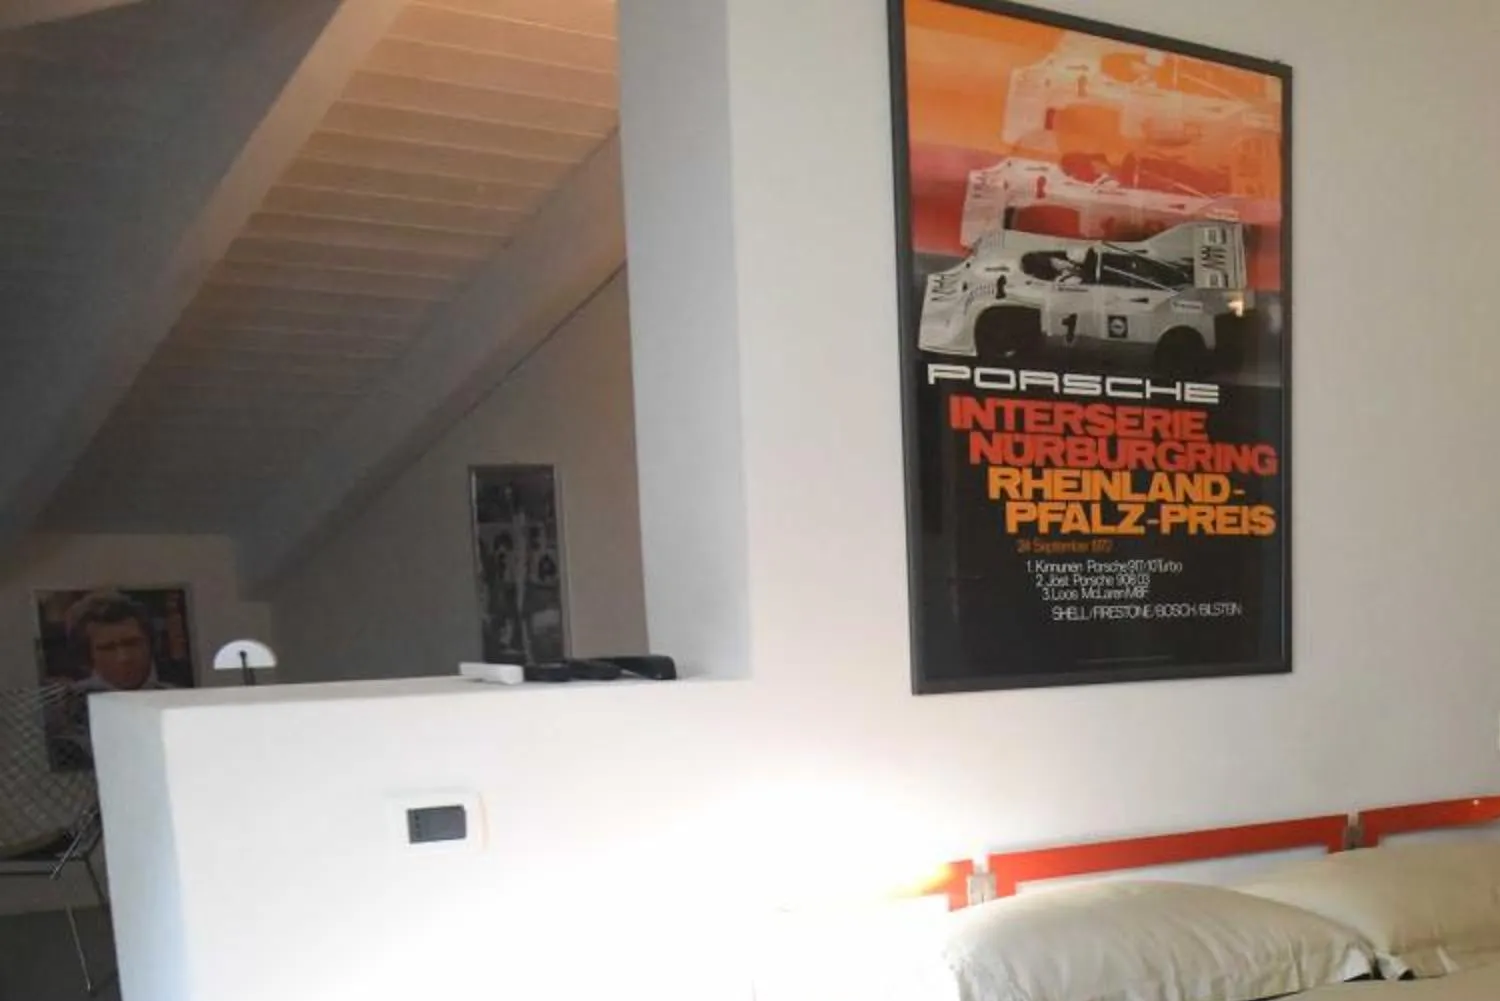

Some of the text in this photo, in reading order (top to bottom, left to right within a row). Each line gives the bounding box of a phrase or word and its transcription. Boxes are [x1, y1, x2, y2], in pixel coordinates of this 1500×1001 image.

[927, 363, 1219, 404] PORSCHE
[949, 395, 1209, 441] INTERSERIE
[1005, 501, 1277, 536] PFALZ-PREIS
